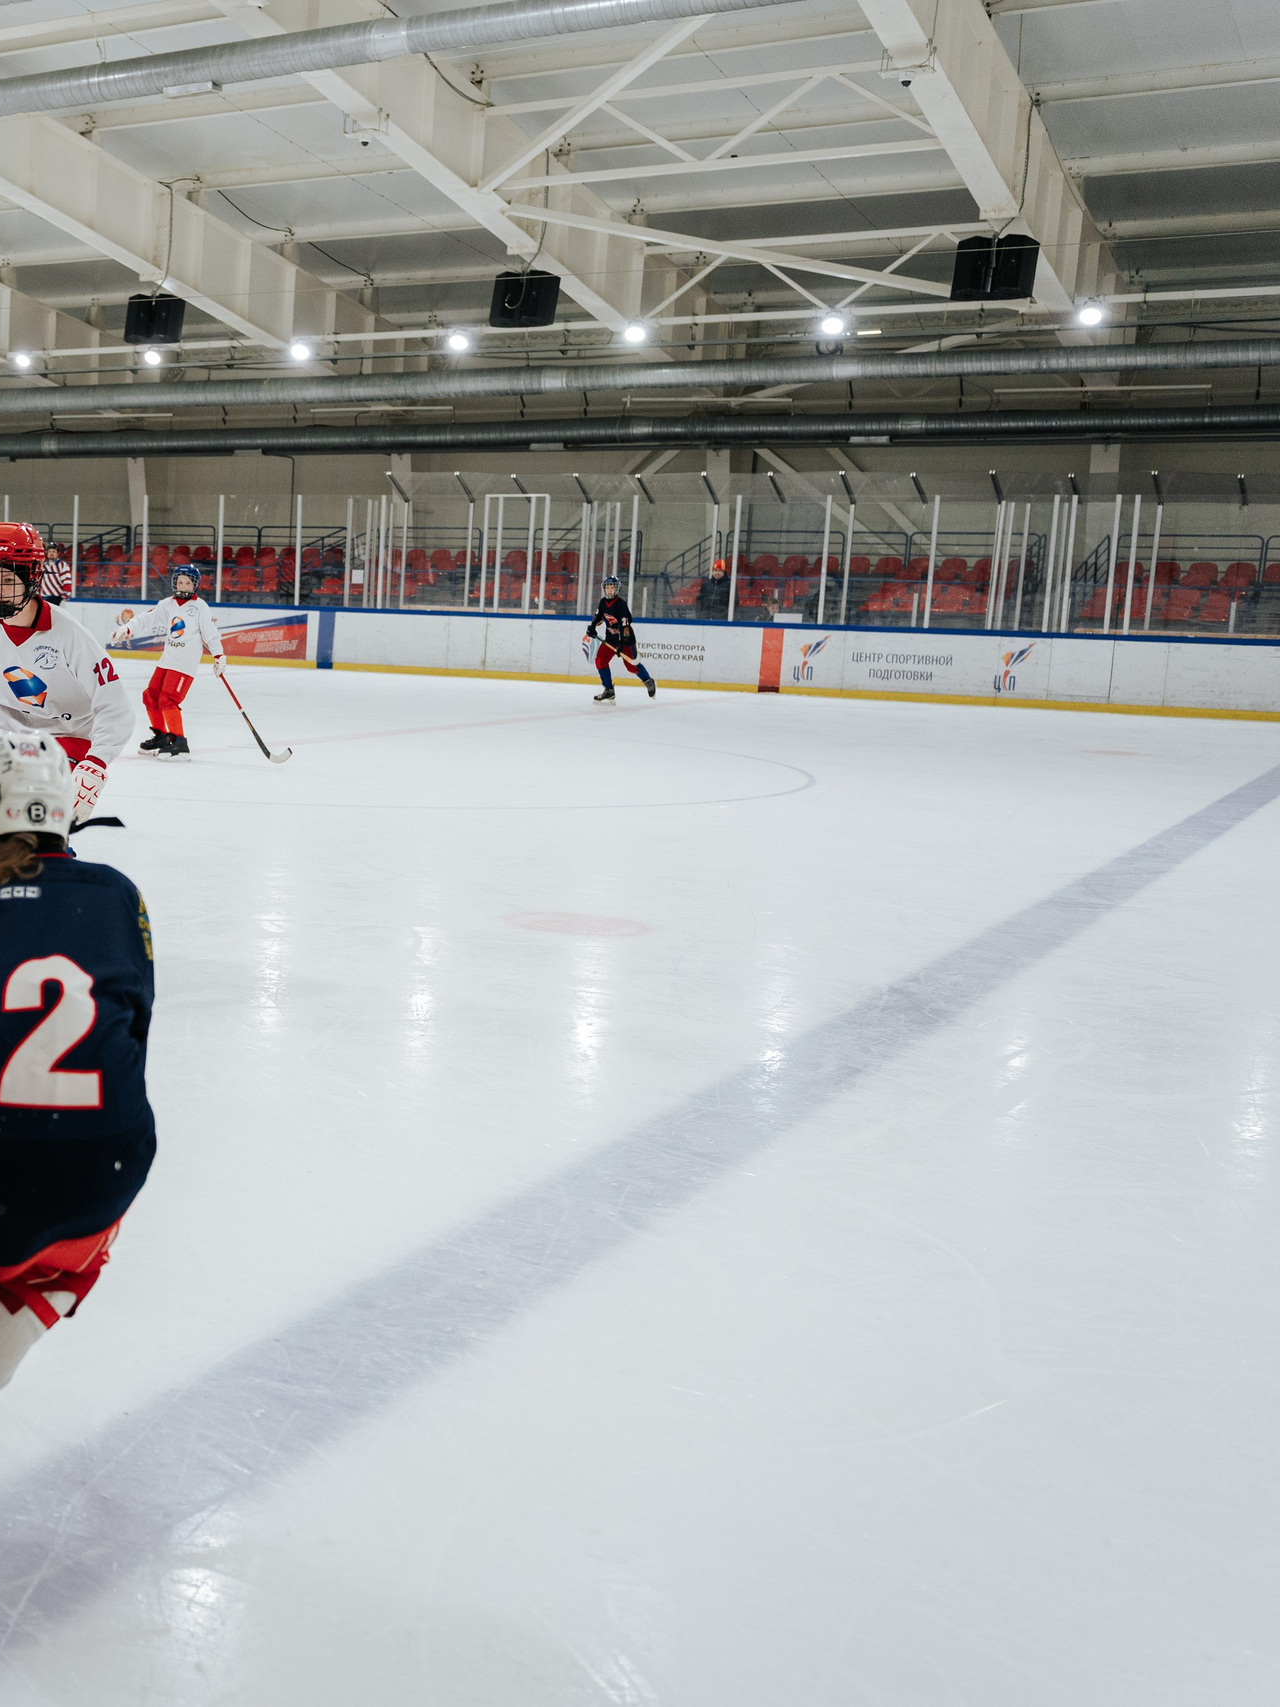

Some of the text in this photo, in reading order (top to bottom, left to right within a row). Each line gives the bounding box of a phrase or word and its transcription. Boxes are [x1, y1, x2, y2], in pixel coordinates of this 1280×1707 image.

[673, 644, 705, 652] СПОРТА
[682, 654, 704, 662] КРАЯ
[852, 652, 953, 666] ЦЕНТР СПОРТИВНОЙ
[93, 657, 120, 687] 12
[868, 668, 933, 682] ПОДГОТОВКИ
[77, 764, 107, 782] STEX
